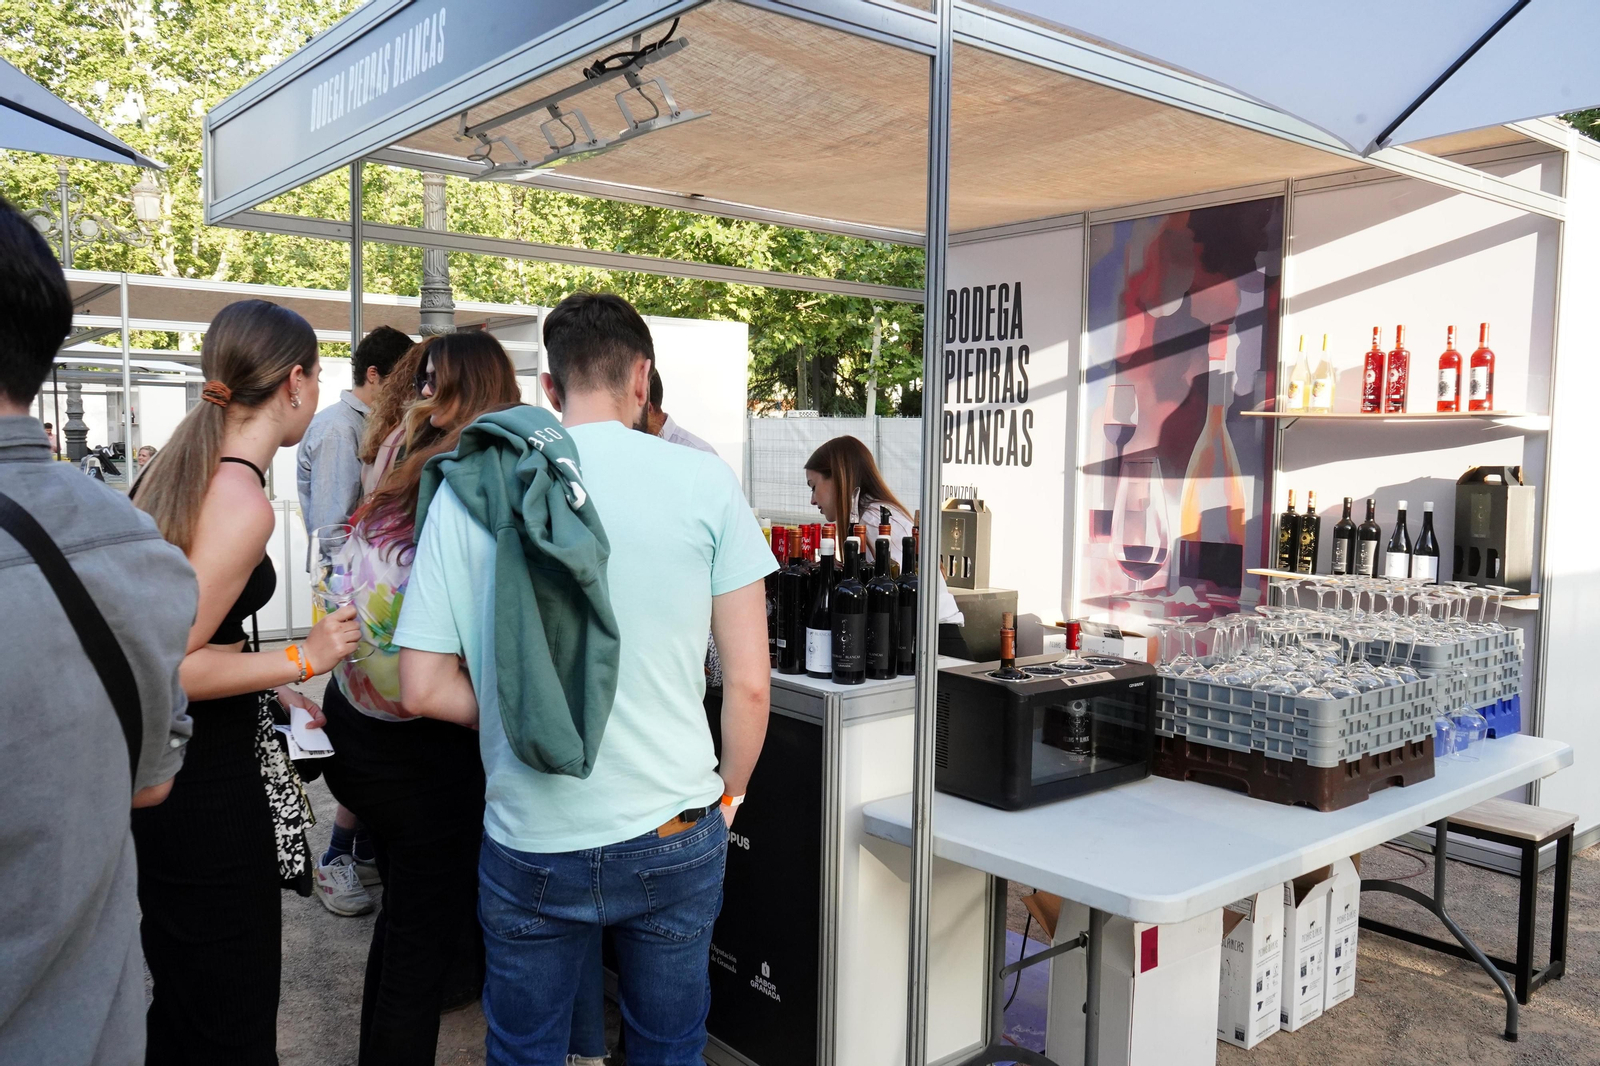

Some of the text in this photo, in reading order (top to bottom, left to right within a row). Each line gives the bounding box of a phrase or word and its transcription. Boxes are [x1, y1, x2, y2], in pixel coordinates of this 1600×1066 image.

[310, 7, 446, 132] BODEGA PIEDRAS BLANCAS
[945, 281, 1023, 344] BODEGA
[944, 344, 1030, 404] PIEDRAS
[942, 408, 1034, 468] BLANCAS
[717, 956, 737, 974] Granada
[749, 979, 781, 1002] GRANADA
[754, 975, 777, 992] SABOR
